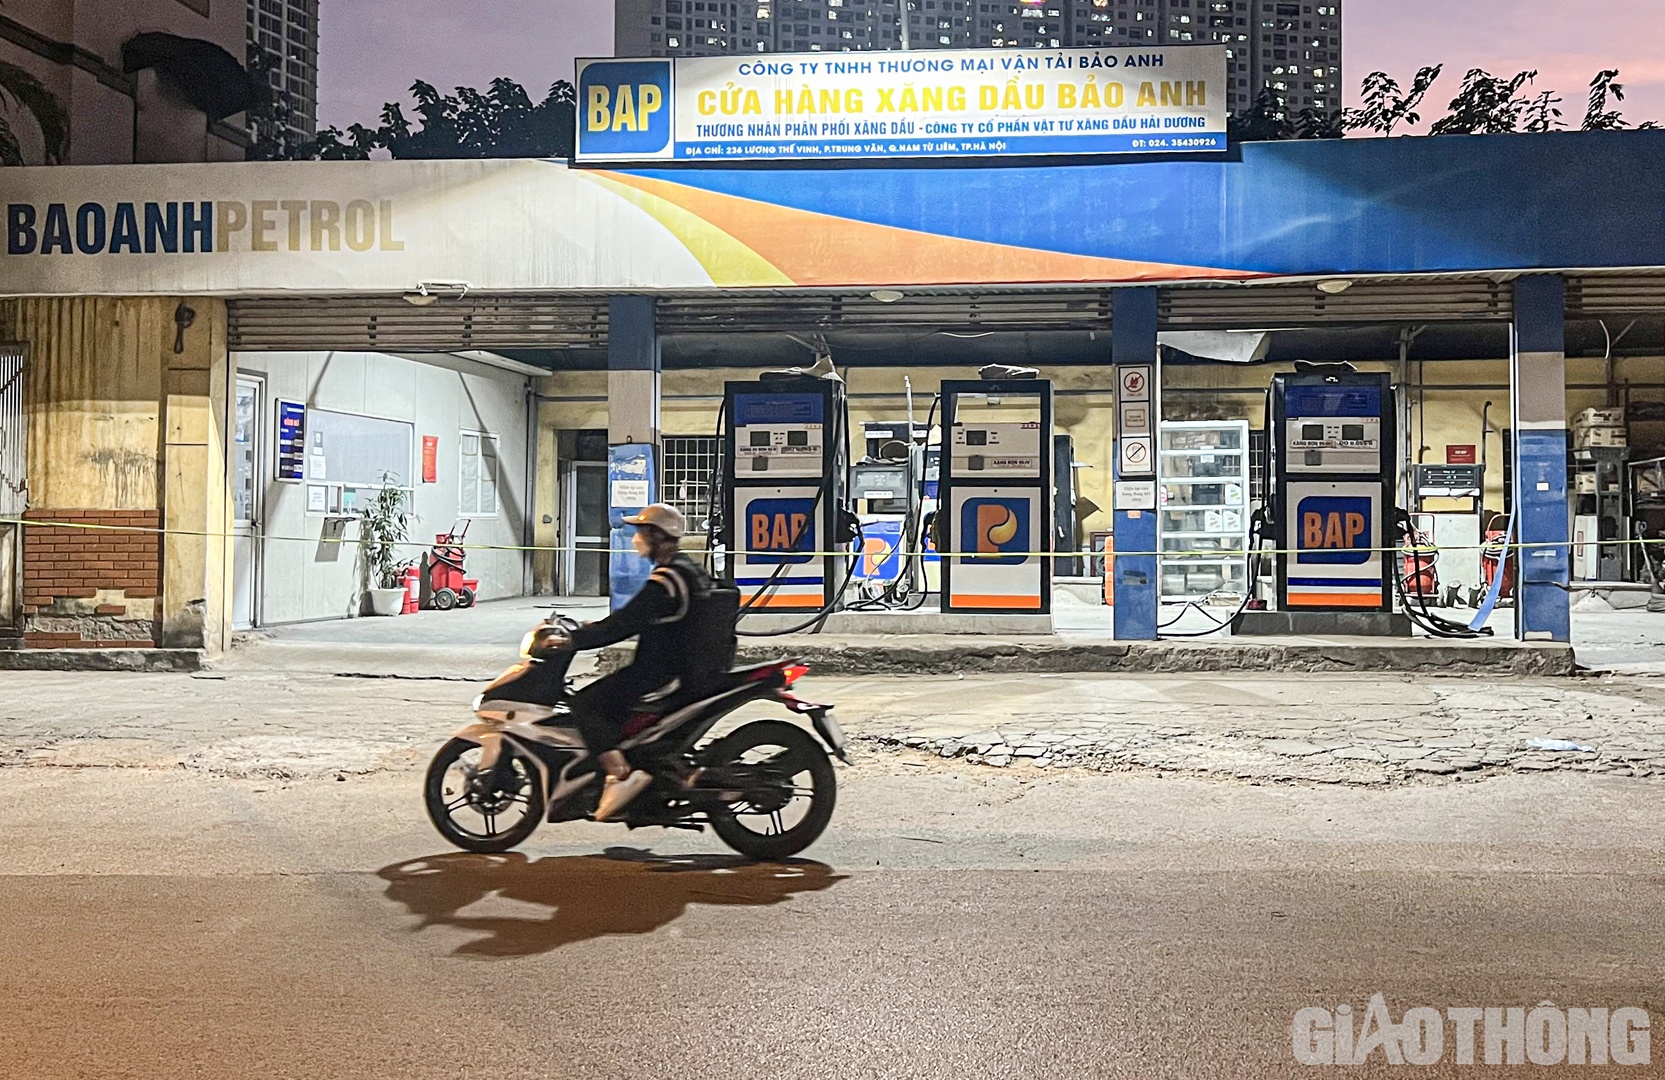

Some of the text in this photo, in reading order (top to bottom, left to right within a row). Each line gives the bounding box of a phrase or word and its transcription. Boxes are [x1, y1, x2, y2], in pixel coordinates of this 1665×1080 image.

[738, 51, 1164, 75] CÔNG TY TNHH THƯƠNG MẠI VẬN TẢI BẢO ANH
[587, 83, 662, 132] BAP
[697, 74, 1206, 116] CỬA HÀNG XĂNG DẦU BẢO ANH
[696, 122, 744, 137] THƯƠNG
[748, 120, 781, 136] NHÂN
[785, 120, 818, 136] PHÂN
[822, 118, 850, 136] PHỐI
[854, 119, 886, 135] XĂNG
[925, 120, 957, 134] CÔNG
[961, 123, 974, 133] TY
[1033, 118, 1055, 133] VẬT
[1058, 118, 1074, 131] TƯ
[1077, 117, 1109, 131] XĂNG
[1140, 114, 1160, 128] HẢI
[1164, 115, 1206, 129] DƯƠNG
[726, 146, 743, 155] 236
[745, 145, 777, 154] LƯƠNG
[1171, 137, 1217, 147] 35430926
[752, 513, 807, 549] BAP
[1304, 511, 1364, 549] BAP
